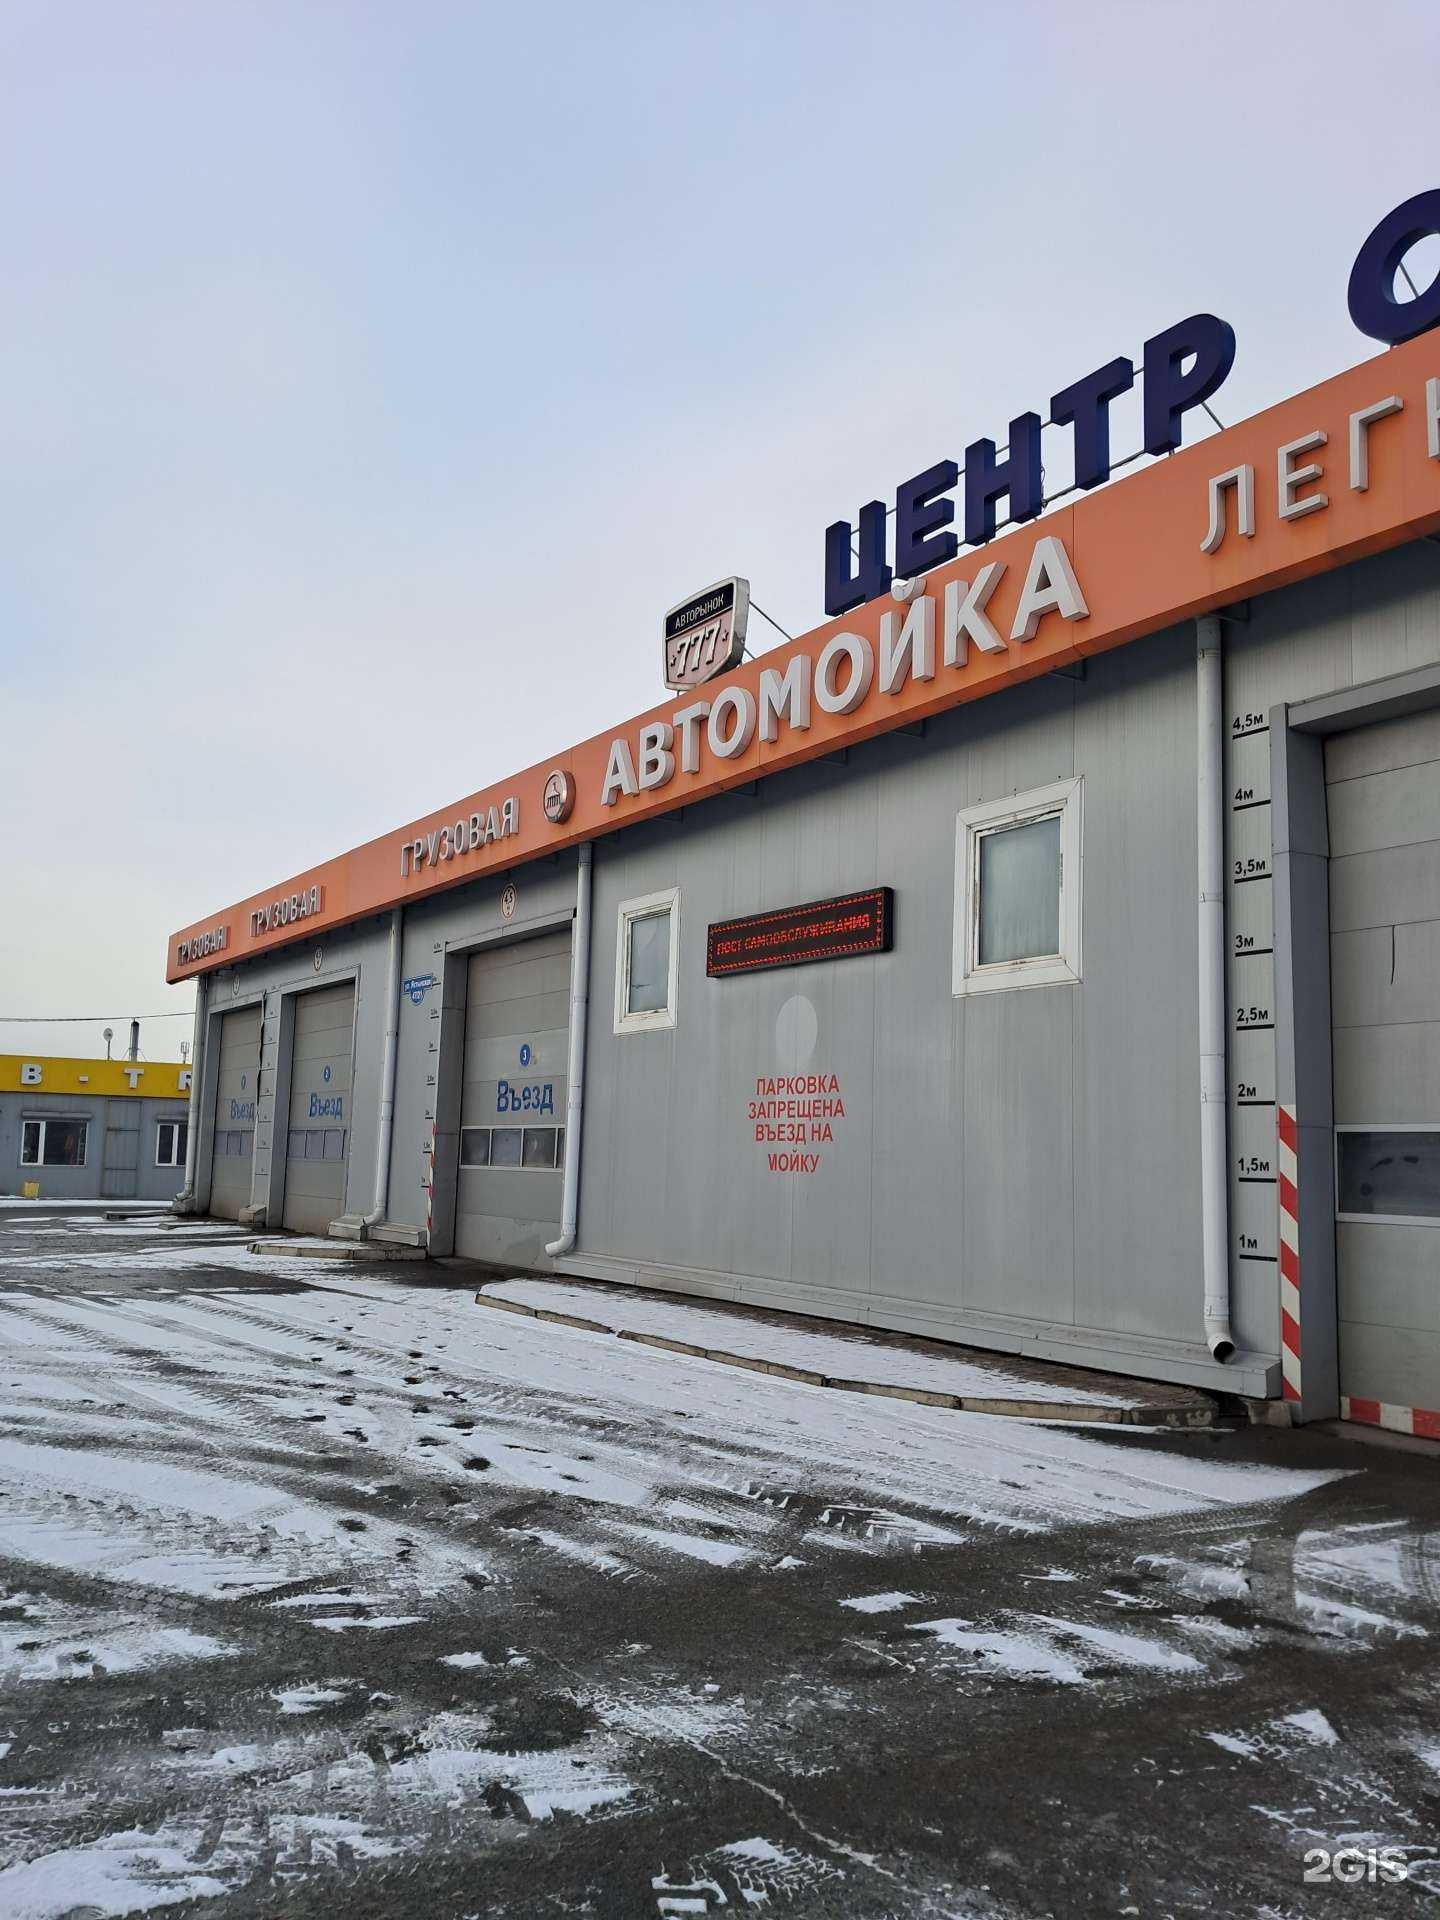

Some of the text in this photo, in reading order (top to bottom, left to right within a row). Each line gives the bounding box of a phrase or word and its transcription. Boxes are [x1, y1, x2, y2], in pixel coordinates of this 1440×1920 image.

[825, 313, 1236, 616] ЦЕНТР
[675, 594, 724, 629] АВТОРЫНОК
[677, 619, 722, 678] 777
[600, 536, 1090, 807] АВТОМОЙКА
[1232, 713, 1264, 731] 4,5м
[1234, 788, 1254, 801] 4м
[400, 796, 521, 877] ГРУЗОВАЯ
[1234, 858, 1266, 877] 3,5м
[250, 885, 321, 937] ГРУЗОВАЯ
[176, 925, 228, 966] ГРУЗОВАЯ
[1235, 934, 1254, 948] 3м
[1236, 1007, 1269, 1024] 2,5м
[756, 1074, 840, 1096] ПАРКОВКА
[1237, 1083, 1257, 1097] 2м
[309, 1093, 343, 1120] Въезд
[496, 1080, 554, 1115] Въезд
[230, 1098, 255, 1122] Въезд
[748, 1099, 845, 1121] ЗАПРЕЩЕНА
[755, 1123, 833, 1144] ВЪЕЗД НА
[1238, 1157, 1270, 1174] 1,5м
[1239, 1234, 1258, 1248] 1м
